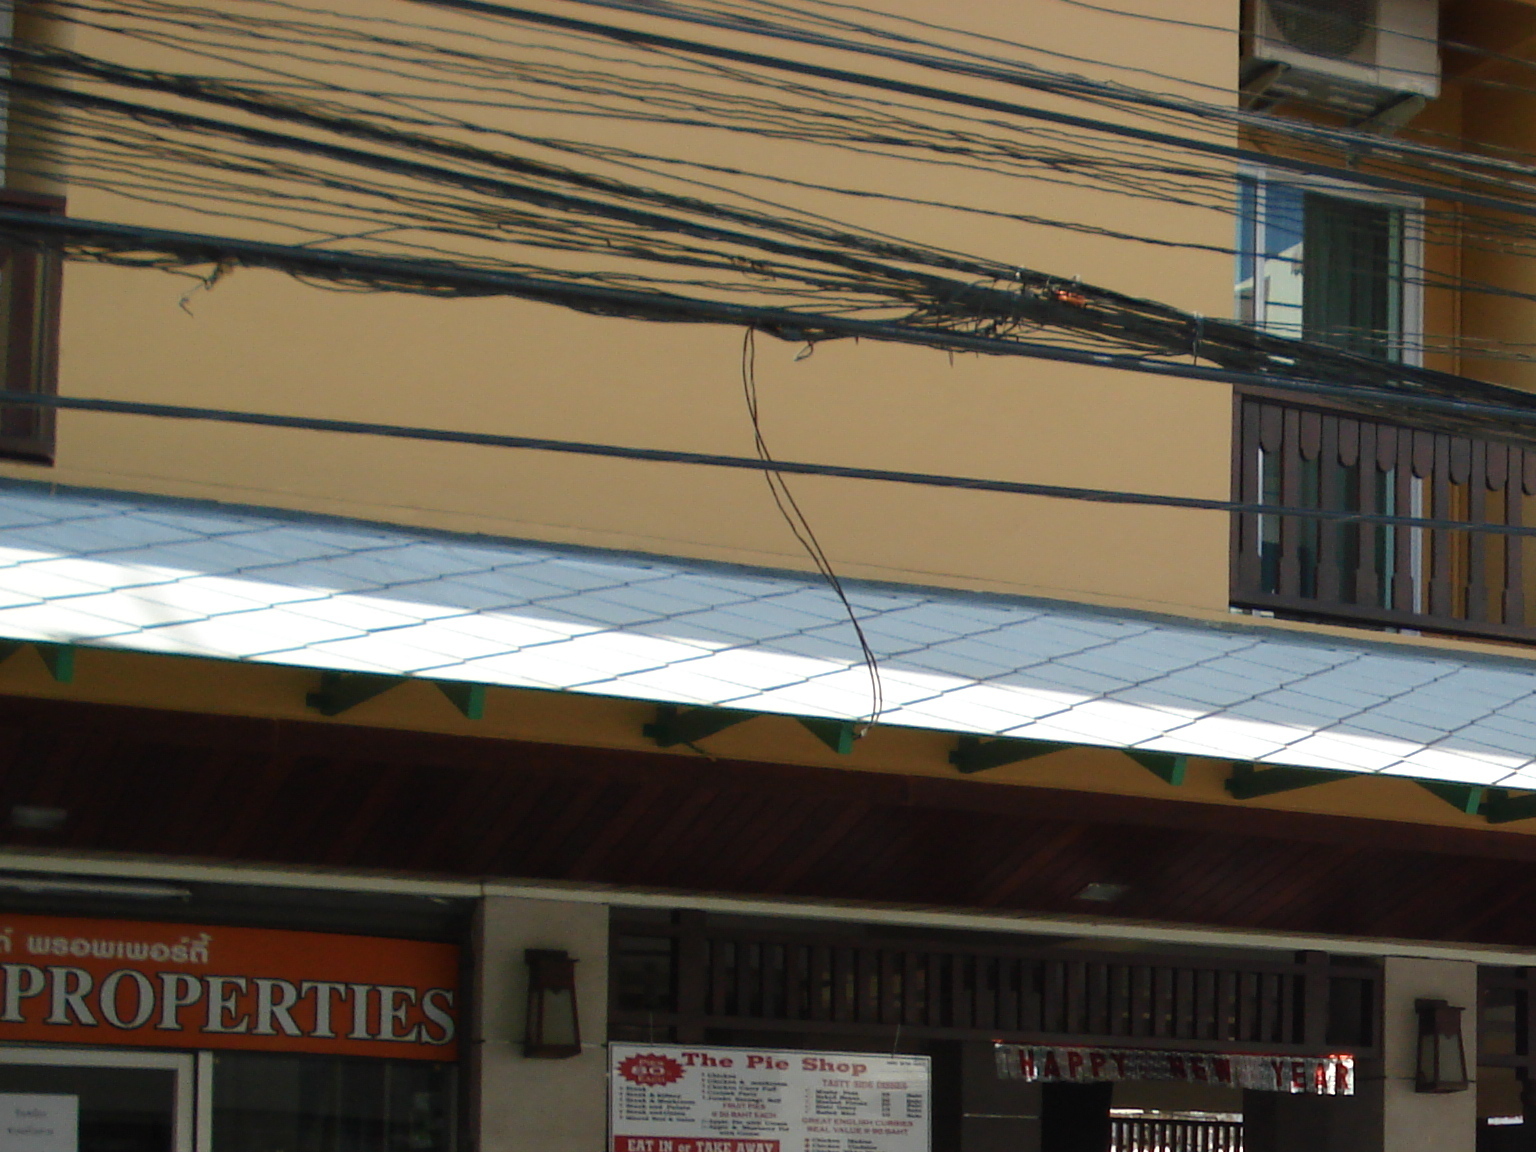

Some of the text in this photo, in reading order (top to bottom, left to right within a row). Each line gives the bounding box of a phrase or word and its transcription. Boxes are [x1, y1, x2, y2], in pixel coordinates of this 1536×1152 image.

[1, 962, 456, 1046] PROPERTIES
[681, 1052, 734, 1068] The
[746, 1054, 790, 1070] Pie
[801, 1057, 868, 1077] Shop
[1019, 1049, 1350, 1090] HAPPY NEW YEAR
[627, 1138, 655, 1152] EAT
[659, 1140, 674, 1152] IN
